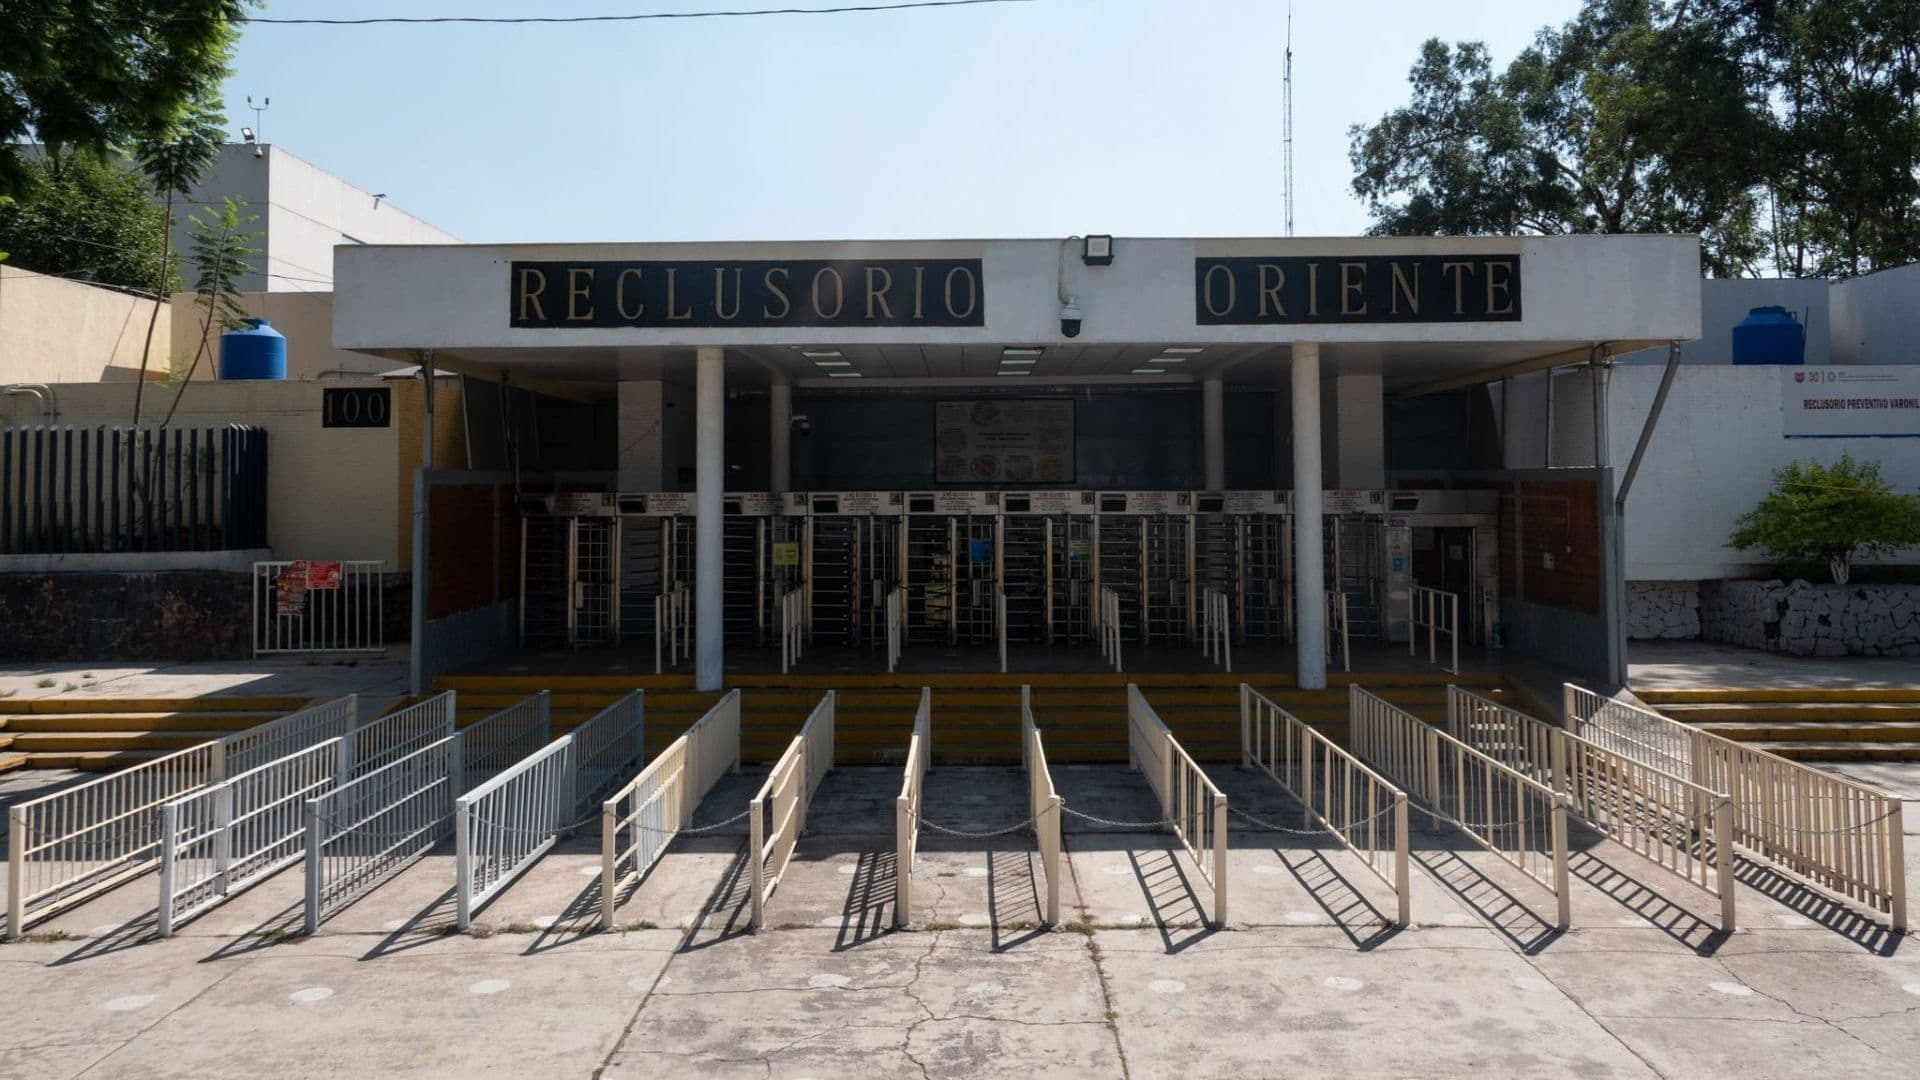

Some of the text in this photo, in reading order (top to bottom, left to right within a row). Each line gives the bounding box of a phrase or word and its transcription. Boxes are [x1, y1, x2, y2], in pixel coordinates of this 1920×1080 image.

[518, 261, 1514, 321] RECLUSORIO ORIENTE
[326, 391, 385, 424] 100
[1803, 399, 1920, 409] RECLUSORIO PREVENTIVO VARONIL
